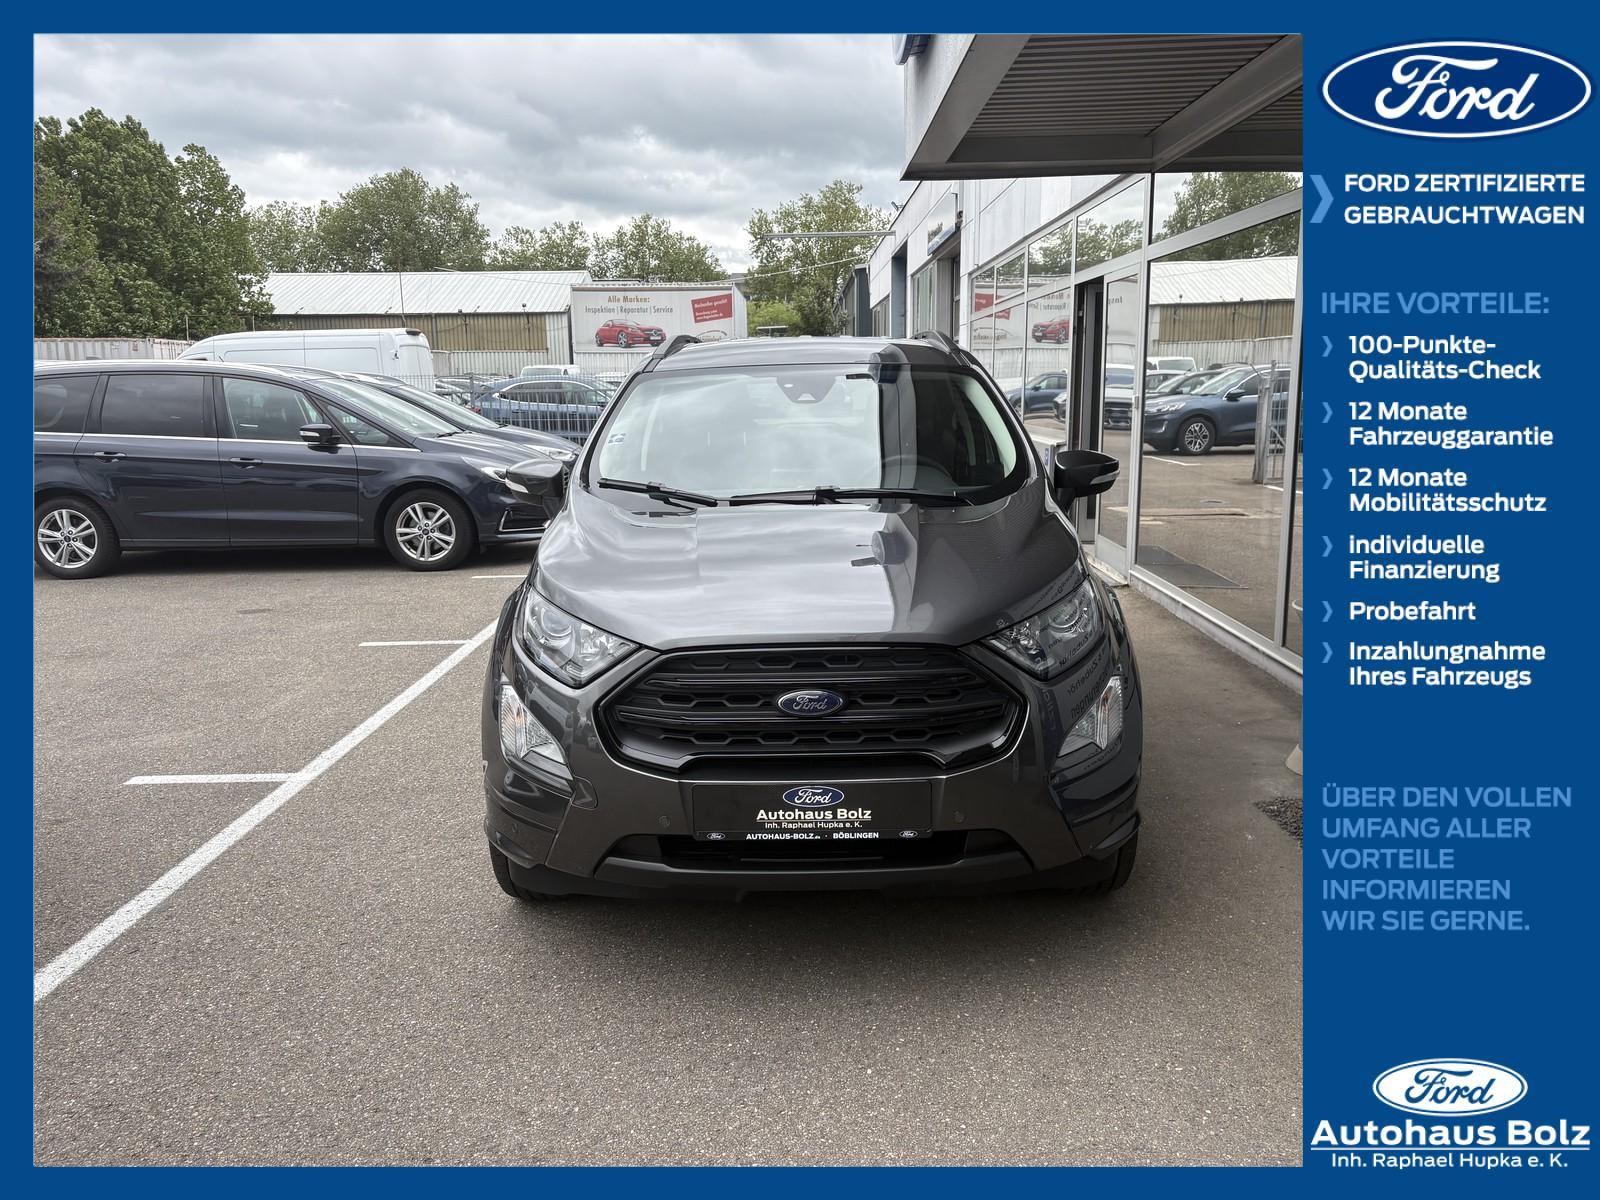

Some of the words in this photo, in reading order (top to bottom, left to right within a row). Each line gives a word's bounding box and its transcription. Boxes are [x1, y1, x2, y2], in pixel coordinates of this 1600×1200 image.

[585, 305, 616, 314] Inspektion
[653, 305, 673, 313] Service
[793, 695, 828, 710] Ford
[795, 788, 832, 804] Ford
[757, 809, 833, 820] Autohaus
[837, 808, 872, 819] Bolz
[782, 821, 816, 830] Raphael
[817, 821, 844, 830] Hupka
